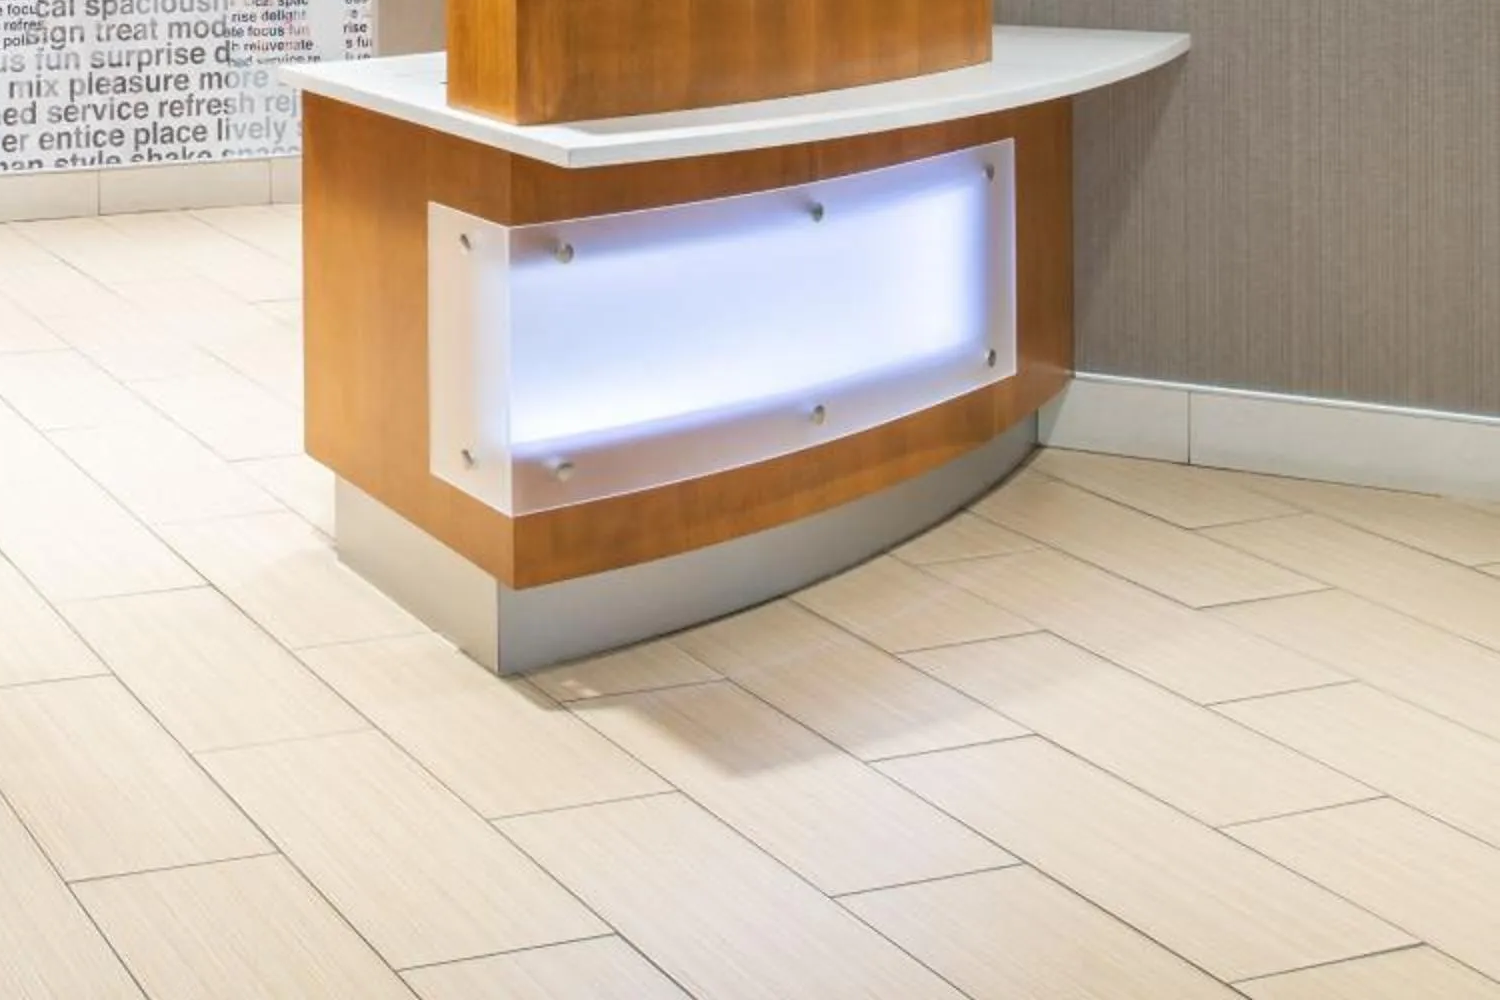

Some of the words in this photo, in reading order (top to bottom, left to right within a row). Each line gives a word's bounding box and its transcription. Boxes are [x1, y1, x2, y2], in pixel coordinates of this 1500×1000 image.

[95, 18, 158, 42] treat
[166, 13, 226, 40] mod
[231, 10, 257, 22] rise
[247, 25, 286, 37] focus
[35, 46, 80, 71] fun
[90, 43, 206, 72] surprise
[8, 74, 59, 99] mix
[69, 69, 189, 101] pleasure
[200, 70, 268, 92] more
[46, 92, 150, 122] service
[158, 90, 256, 118] refresh
[38, 121, 125, 151] entice
[133, 116, 208, 148] place
[216, 117, 287, 143] lively
